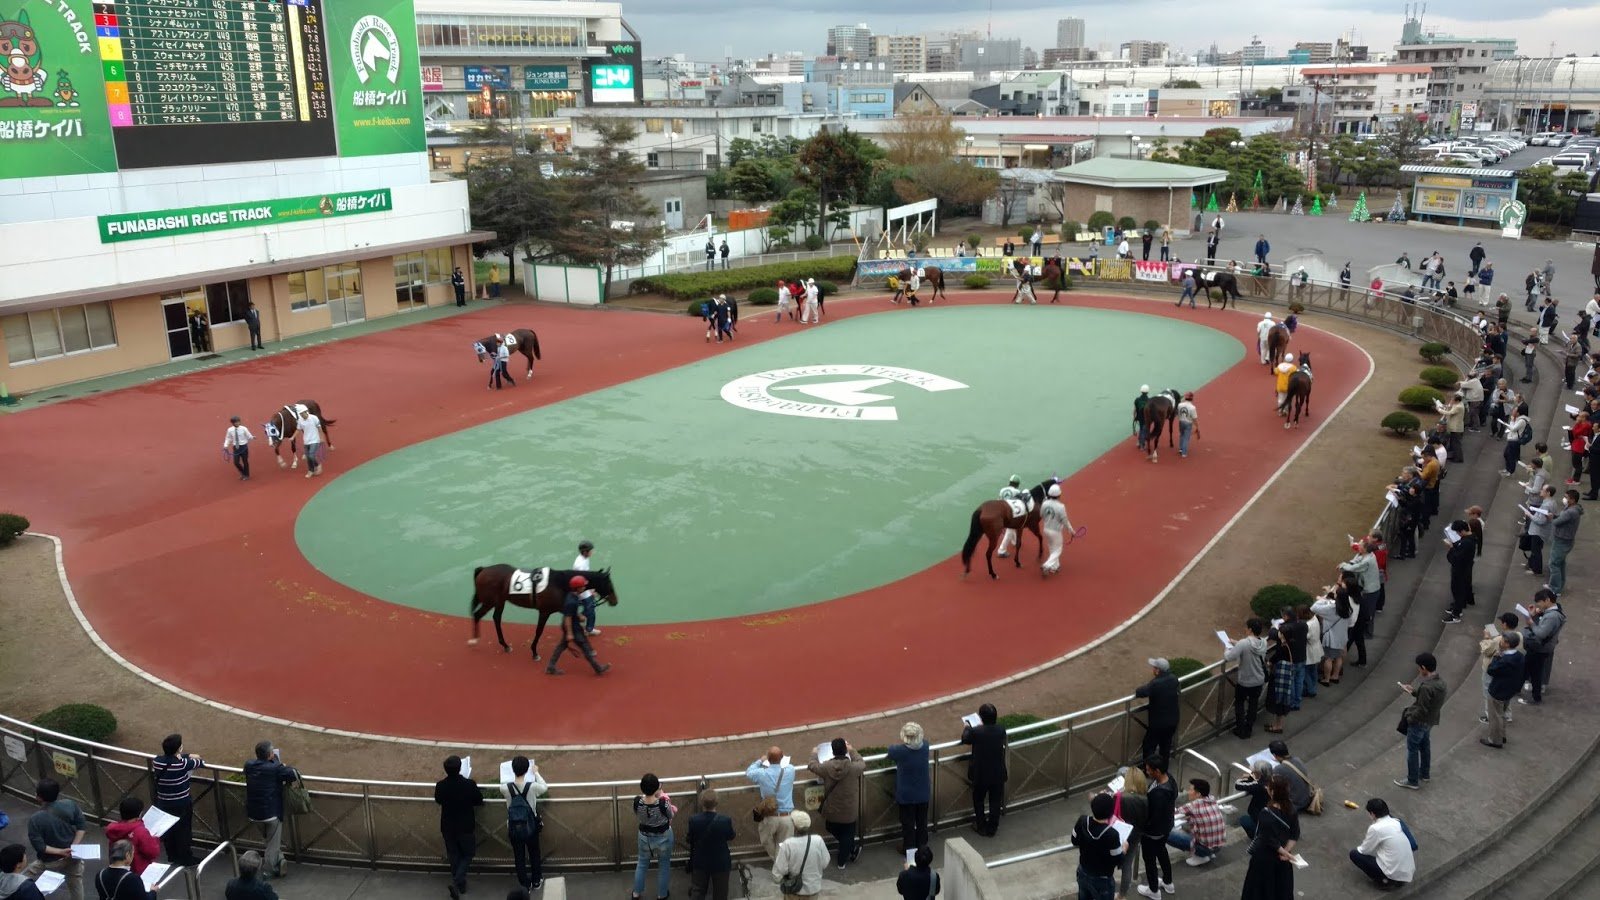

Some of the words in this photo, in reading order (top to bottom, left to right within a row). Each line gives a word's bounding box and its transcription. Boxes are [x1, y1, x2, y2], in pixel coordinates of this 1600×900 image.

[102, 5, 108, 14] 2
[125, 6, 131, 15] 2
[214, 11, 228, 20] 439
[212, 0, 226, 9] 462
[305, 6, 316, 14] 3.3
[57, 1, 92, 53] TRACK
[104, 16, 109, 25] 3
[127, 17, 132, 26] 3
[215, 22, 228, 30] 417
[304, 24, 318, 34] 81.2
[104, 28, 110, 36] 4
[129, 29, 134, 38] 4
[216, 32, 230, 40] 449
[245, 32, 258, 41] 和田
[308, 34, 318, 43] 7.8
[130, 40, 136, 48] 5
[218, 42, 232, 50] 419
[309, 44, 320, 52] 6.6
[353, 18, 370, 72] Funabashi
[372, 17, 392, 38] Race
[390, 38, 398, 72] Track
[132, 51, 138, 60] 6
[220, 52, 232, 60] 428
[248, 53, 262, 61] 本田
[308, 54, 320, 62] 13.2
[111, 66, 116, 75] 6
[134, 62, 138, 70] 7
[221, 63, 234, 71] 452
[308, 63, 322, 72] 42.1
[136, 72, 141, 81] 8
[312, 72, 322, 80] 6.7
[422, 68, 442, 82] 松屋
[594, 68, 630, 86] ニトリ
[114, 89, 120, 98] 7
[137, 84, 142, 92] 9
[224, 83, 236, 91] 438
[251, 83, 264, 91] 田中
[314, 82, 324, 90] 129
[134, 94, 144, 103] 10
[225, 93, 238, 101] 414
[311, 92, 325, 100] 24.6
[353, 89, 407, 106] 船橋ケイバ
[136, 105, 146, 113] 11
[162, 104, 206, 112] ブラックリリー
[226, 103, 240, 111] 470
[312, 100, 326, 109] 15.8
[118, 112, 124, 120] 8
[138, 116, 148, 124] 12
[228, 112, 240, 121] 465
[316, 110, 327, 118] 3.3
[354, 117, 410, 126] www.f-keiba.com
[0, 118, 82, 138] 船橋ケイバ
[336, 192, 386, 212] 船橋ケイバ
[107, 214, 188, 235] FUNABASHI
[192, 211, 228, 226] RACE
[230, 206, 272, 222] TRACK
[860, 365, 935, 385] Track
[514, 575, 524, 592] 6
